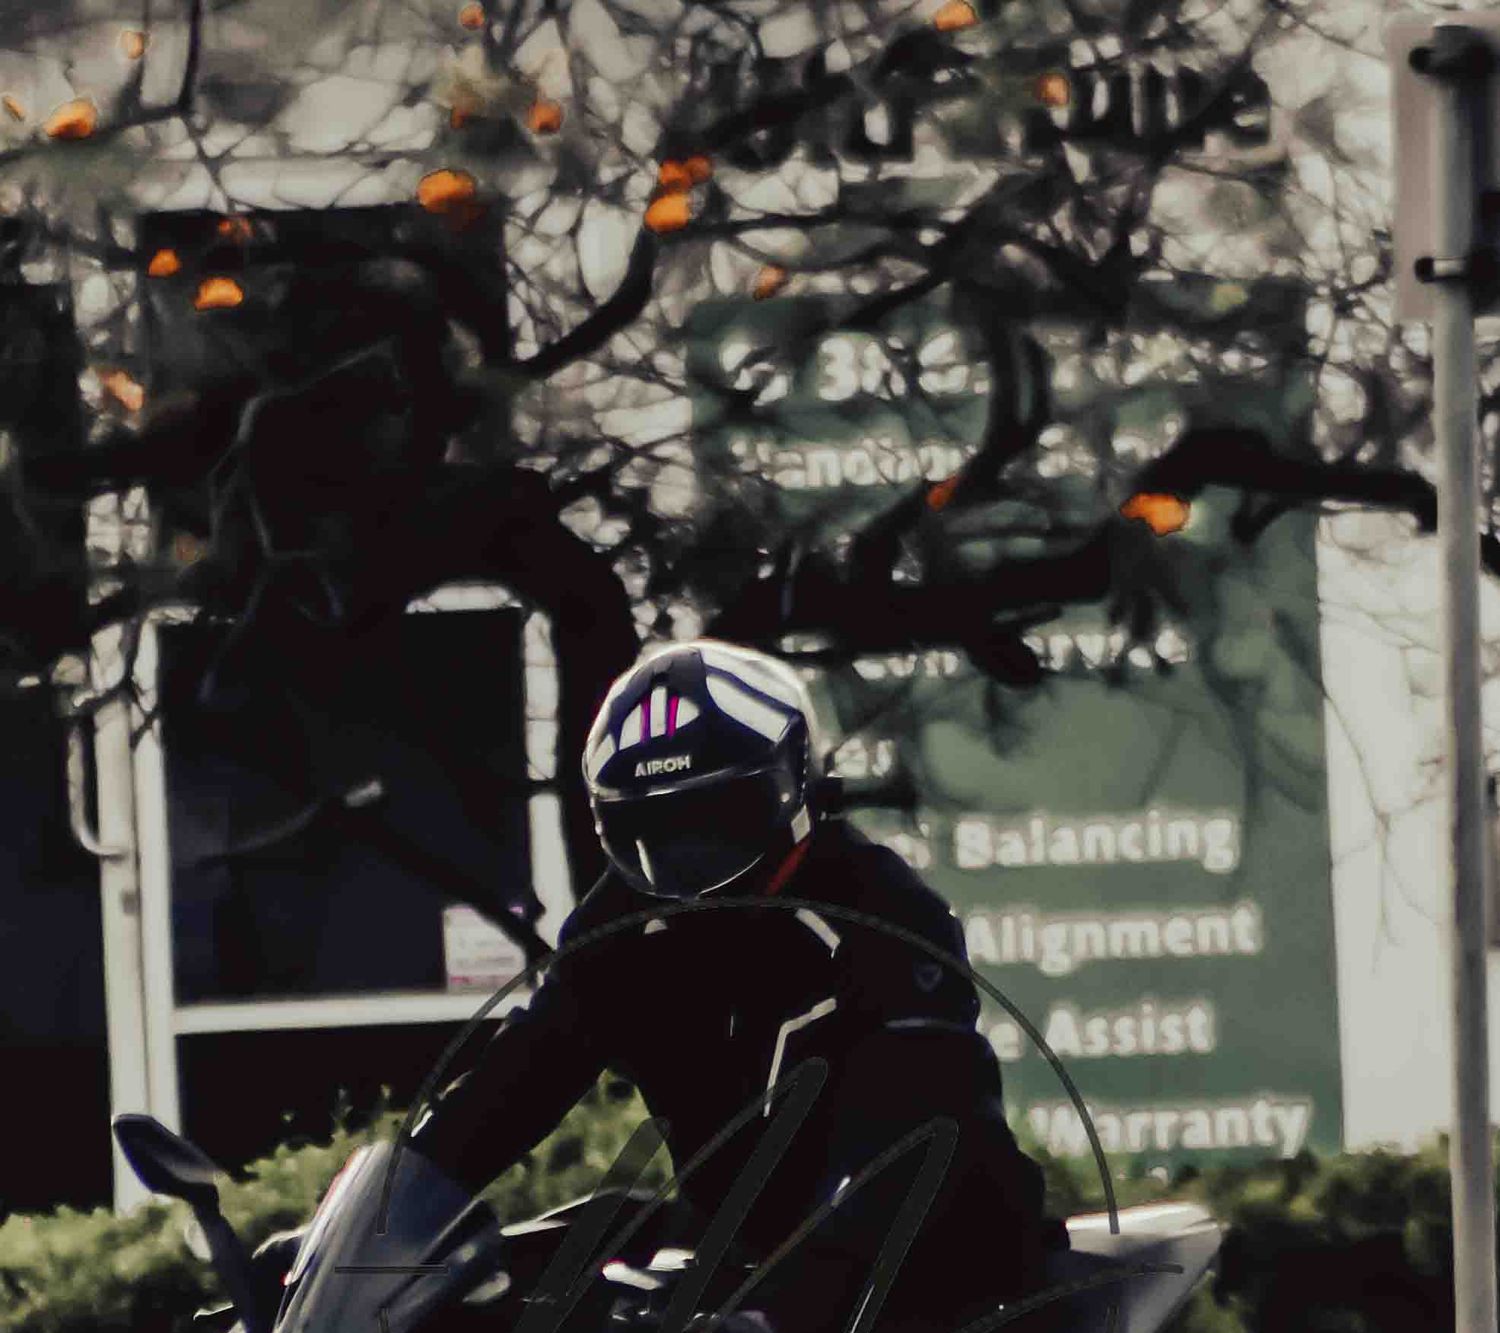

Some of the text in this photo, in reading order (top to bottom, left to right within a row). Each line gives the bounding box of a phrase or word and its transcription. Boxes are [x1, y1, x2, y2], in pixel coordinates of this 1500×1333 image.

[634, 753, 693, 779] AIROH
[955, 810, 1241, 873] Balancing
[965, 904, 1263, 975] Alignment
[1044, 1004, 1216, 1057] Assist
[1029, 1099, 1308, 1158] Warranty
